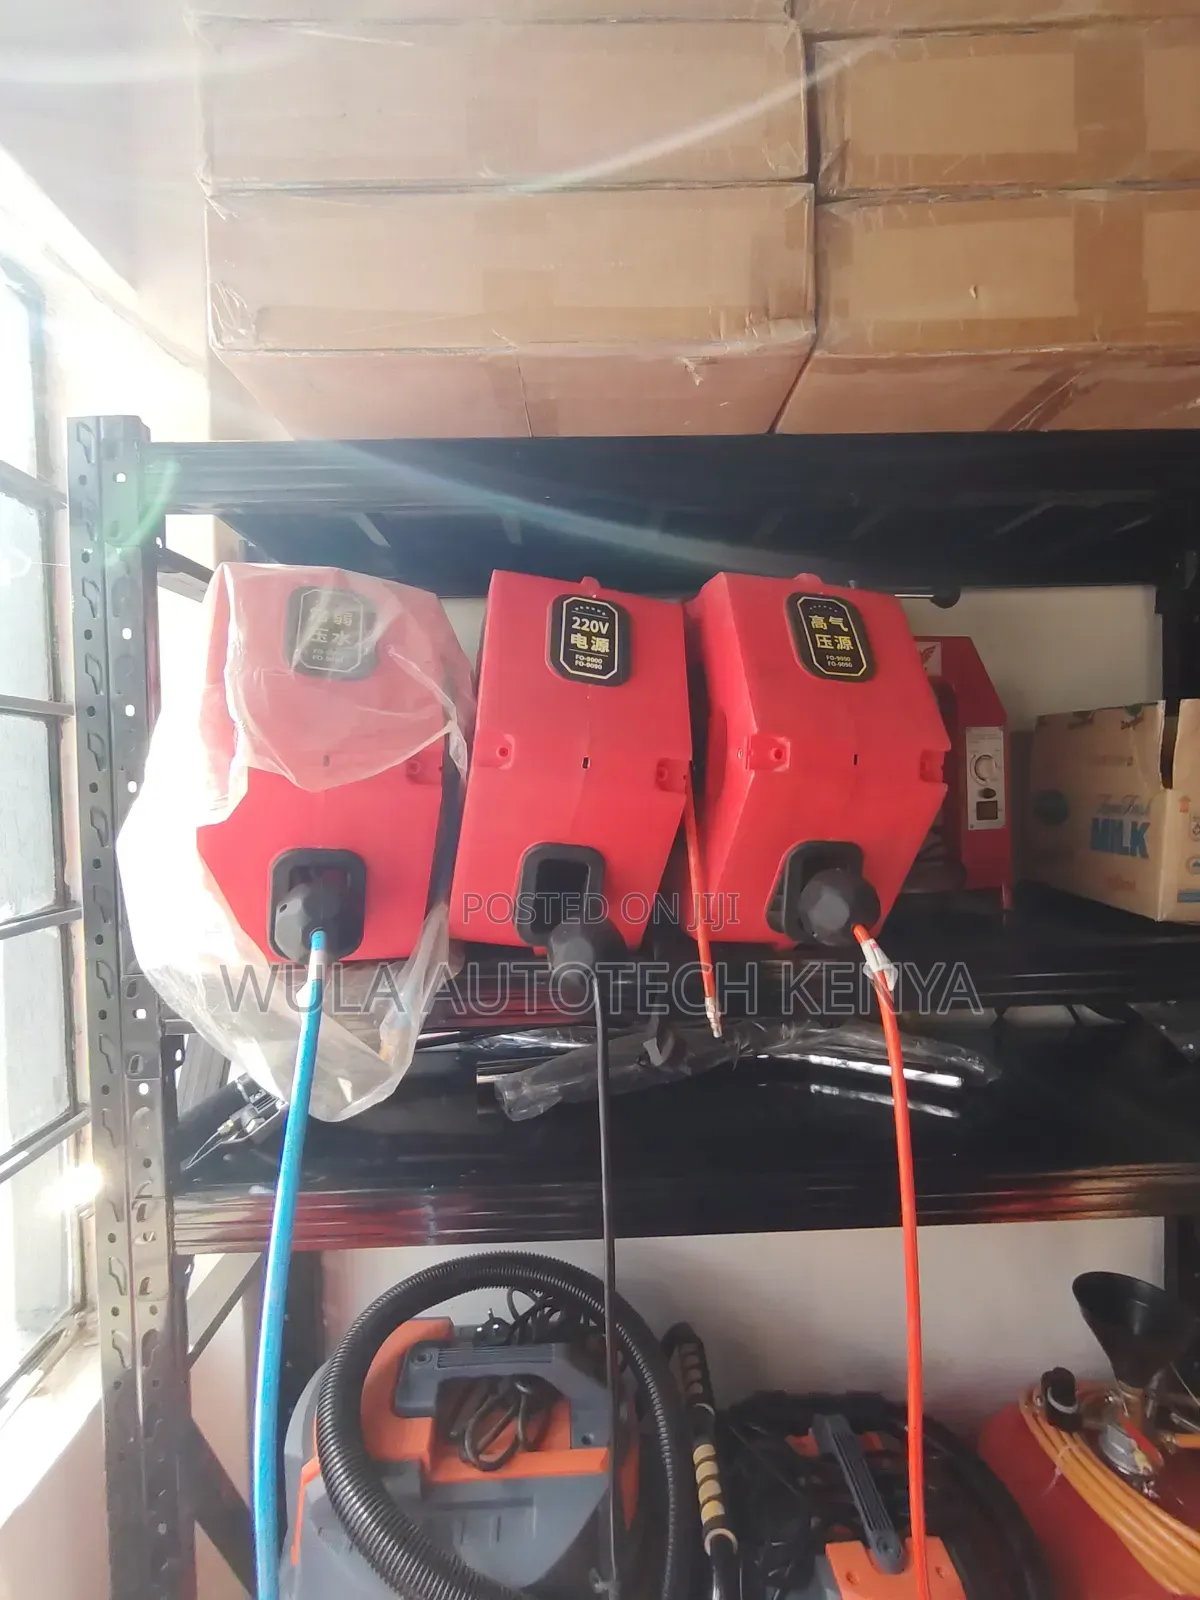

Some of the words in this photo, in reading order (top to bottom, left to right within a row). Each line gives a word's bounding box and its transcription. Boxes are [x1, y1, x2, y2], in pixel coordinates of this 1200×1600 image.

[571, 616, 609, 634] 220V
[570, 633, 610, 652] 电源
[1091, 818, 1151, 859] MILK
